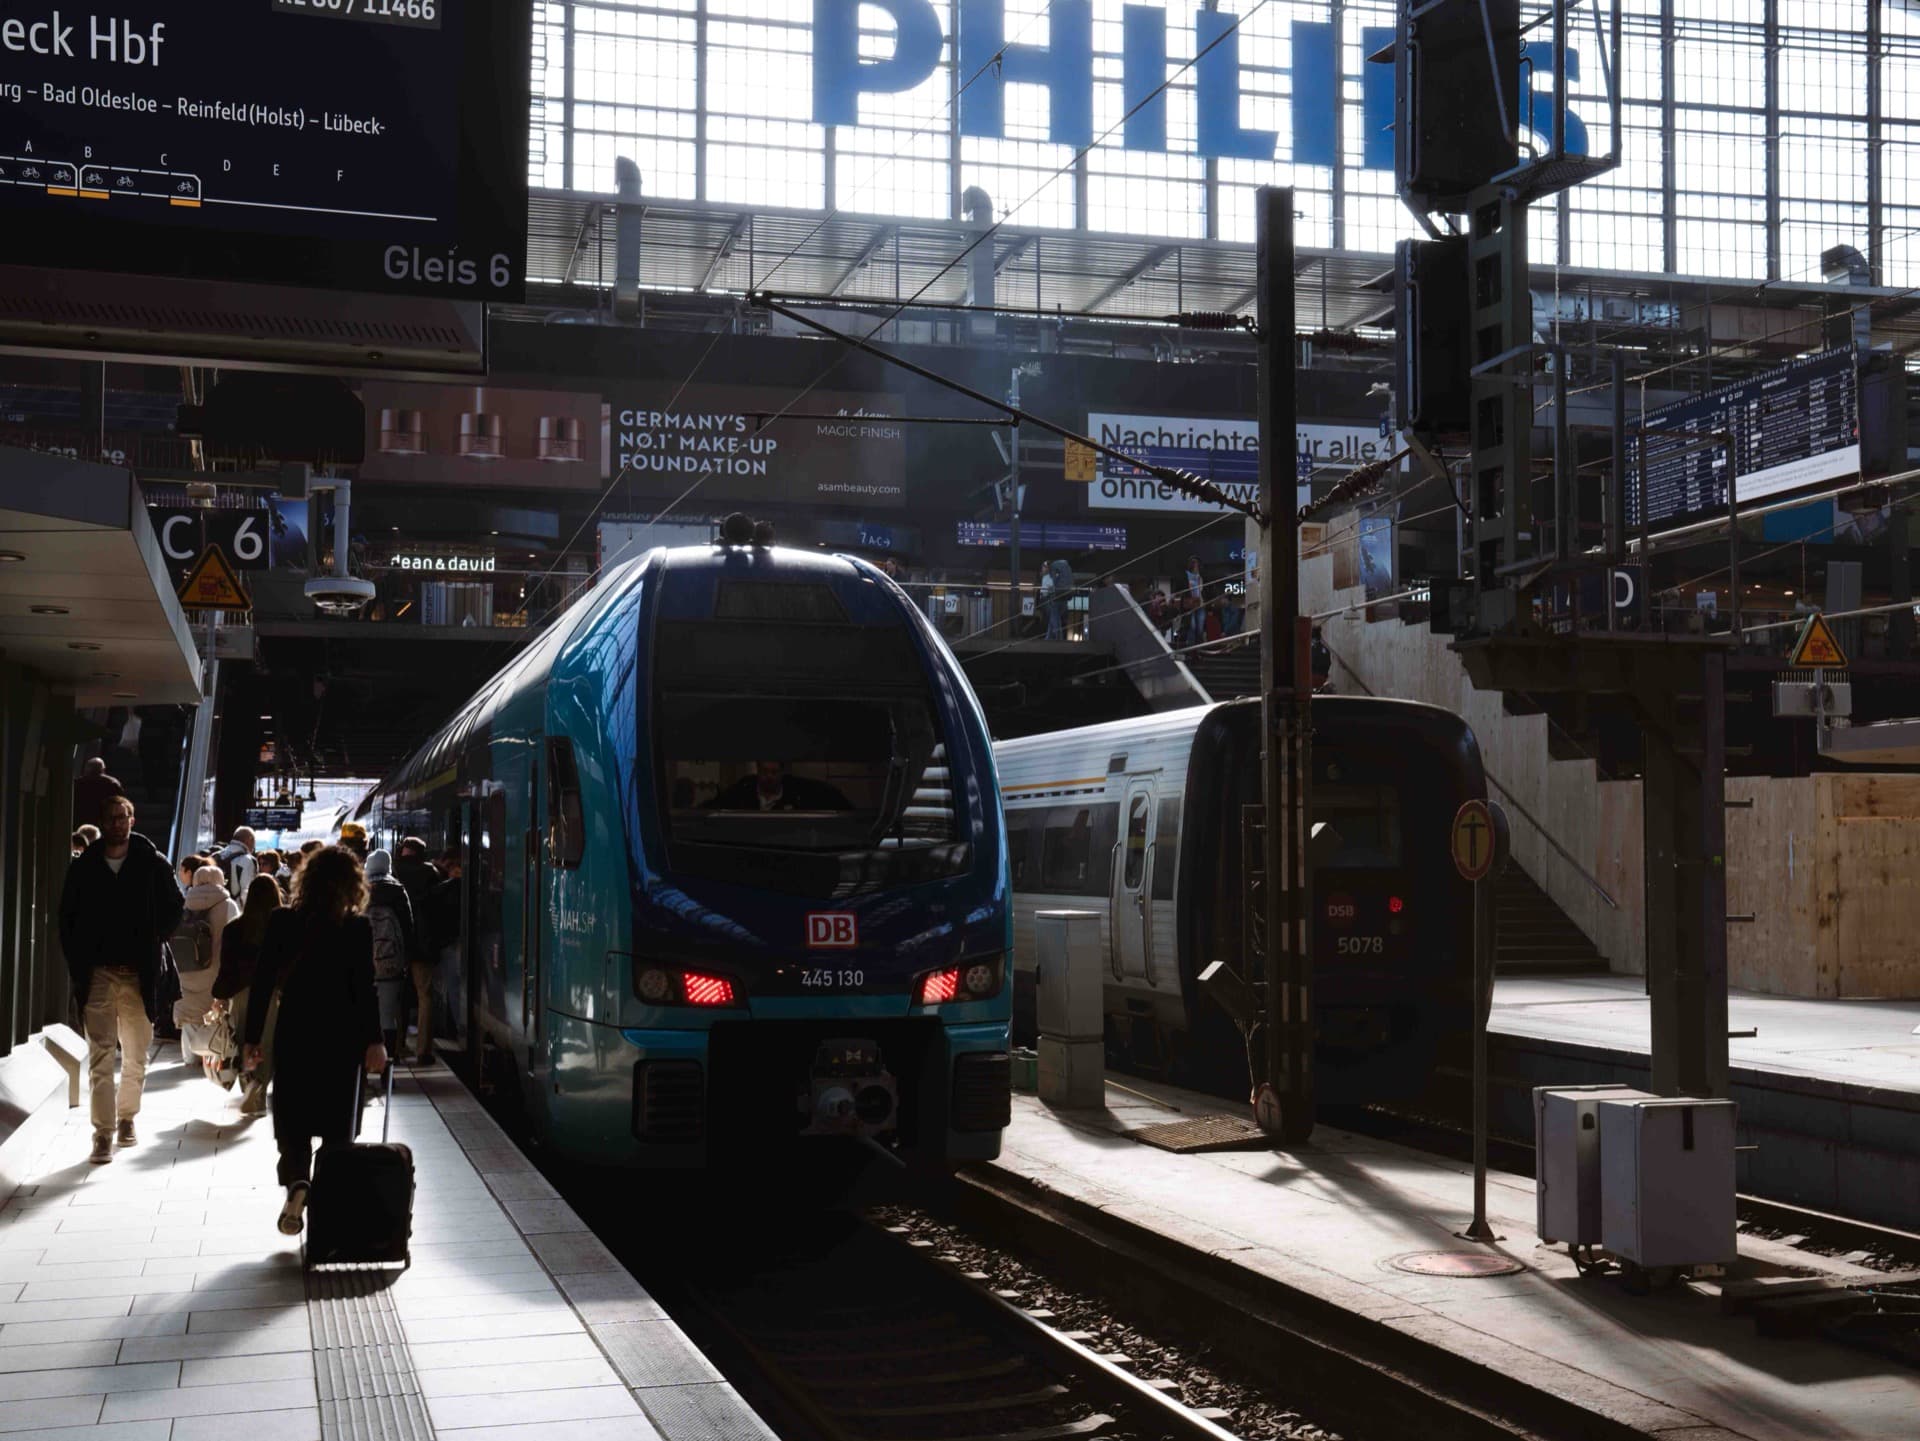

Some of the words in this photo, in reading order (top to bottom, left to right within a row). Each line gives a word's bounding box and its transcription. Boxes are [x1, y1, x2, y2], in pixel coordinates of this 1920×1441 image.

[363, 0, 436, 20] 11466
[1, 11, 75, 57] eck
[90, 15, 165, 67] Hbf
[0, 83, 21, 103] rg
[43, 83, 76, 105] Bad
[81, 87, 158, 113] Oldesloe
[323, 113, 386, 136] Lübeck-
[25, 140, 33, 153] A
[84, 146, 92, 159] B
[160, 154, 168, 166] C
[223, 160, 231, 172] D
[273, 164, 280, 177] E
[337, 170, 343, 182] F
[384, 245, 477, 285] Gleis
[489, 253, 510, 288] 6
[619, 410, 746, 433] GERMANY'S
[817, 424, 857, 438] MAGIC
[859, 426, 901, 440] FINISH
[679, 435, 777, 455] MAKE-UP
[1101, 423, 1259, 452] Nachrichte
[1329, 435, 1377, 460] alle
[619, 453, 767, 476] FOUNDATION
[817, 482, 901, 496] asambeauty.com
[162, 515, 195, 560] C
[233, 516, 264, 560] 6
[1224, 580, 1247, 595] asi
[1328, 904, 1354, 917] DSB
[811, 918, 852, 944] DB
[1337, 936, 1384, 954] 5078
[801, 970, 833, 988] 445
[837, 970, 864, 988] 130
